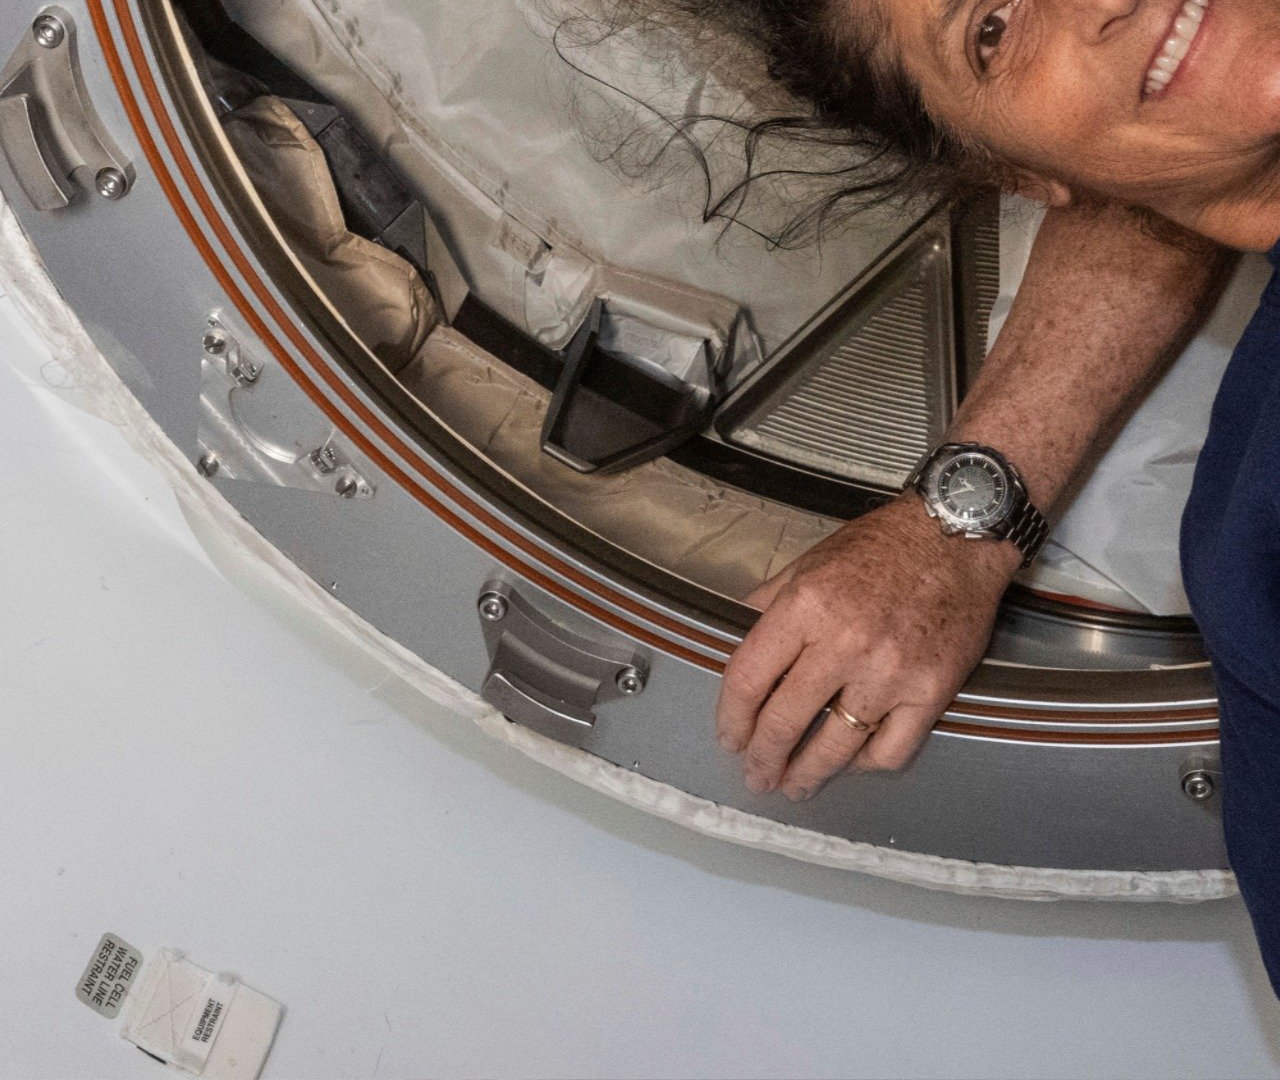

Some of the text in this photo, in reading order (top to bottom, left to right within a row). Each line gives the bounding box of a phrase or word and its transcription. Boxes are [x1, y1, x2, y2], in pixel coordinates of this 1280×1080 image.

[82, 939, 116, 997] RESTRAINT
[91, 946, 128, 1007] WATER LINE
[105, 956, 138, 1009] FUEL CELL
[192, 998, 216, 1042] EQUIPMENT
[201, 1001, 224, 1043] RESTRAINT
